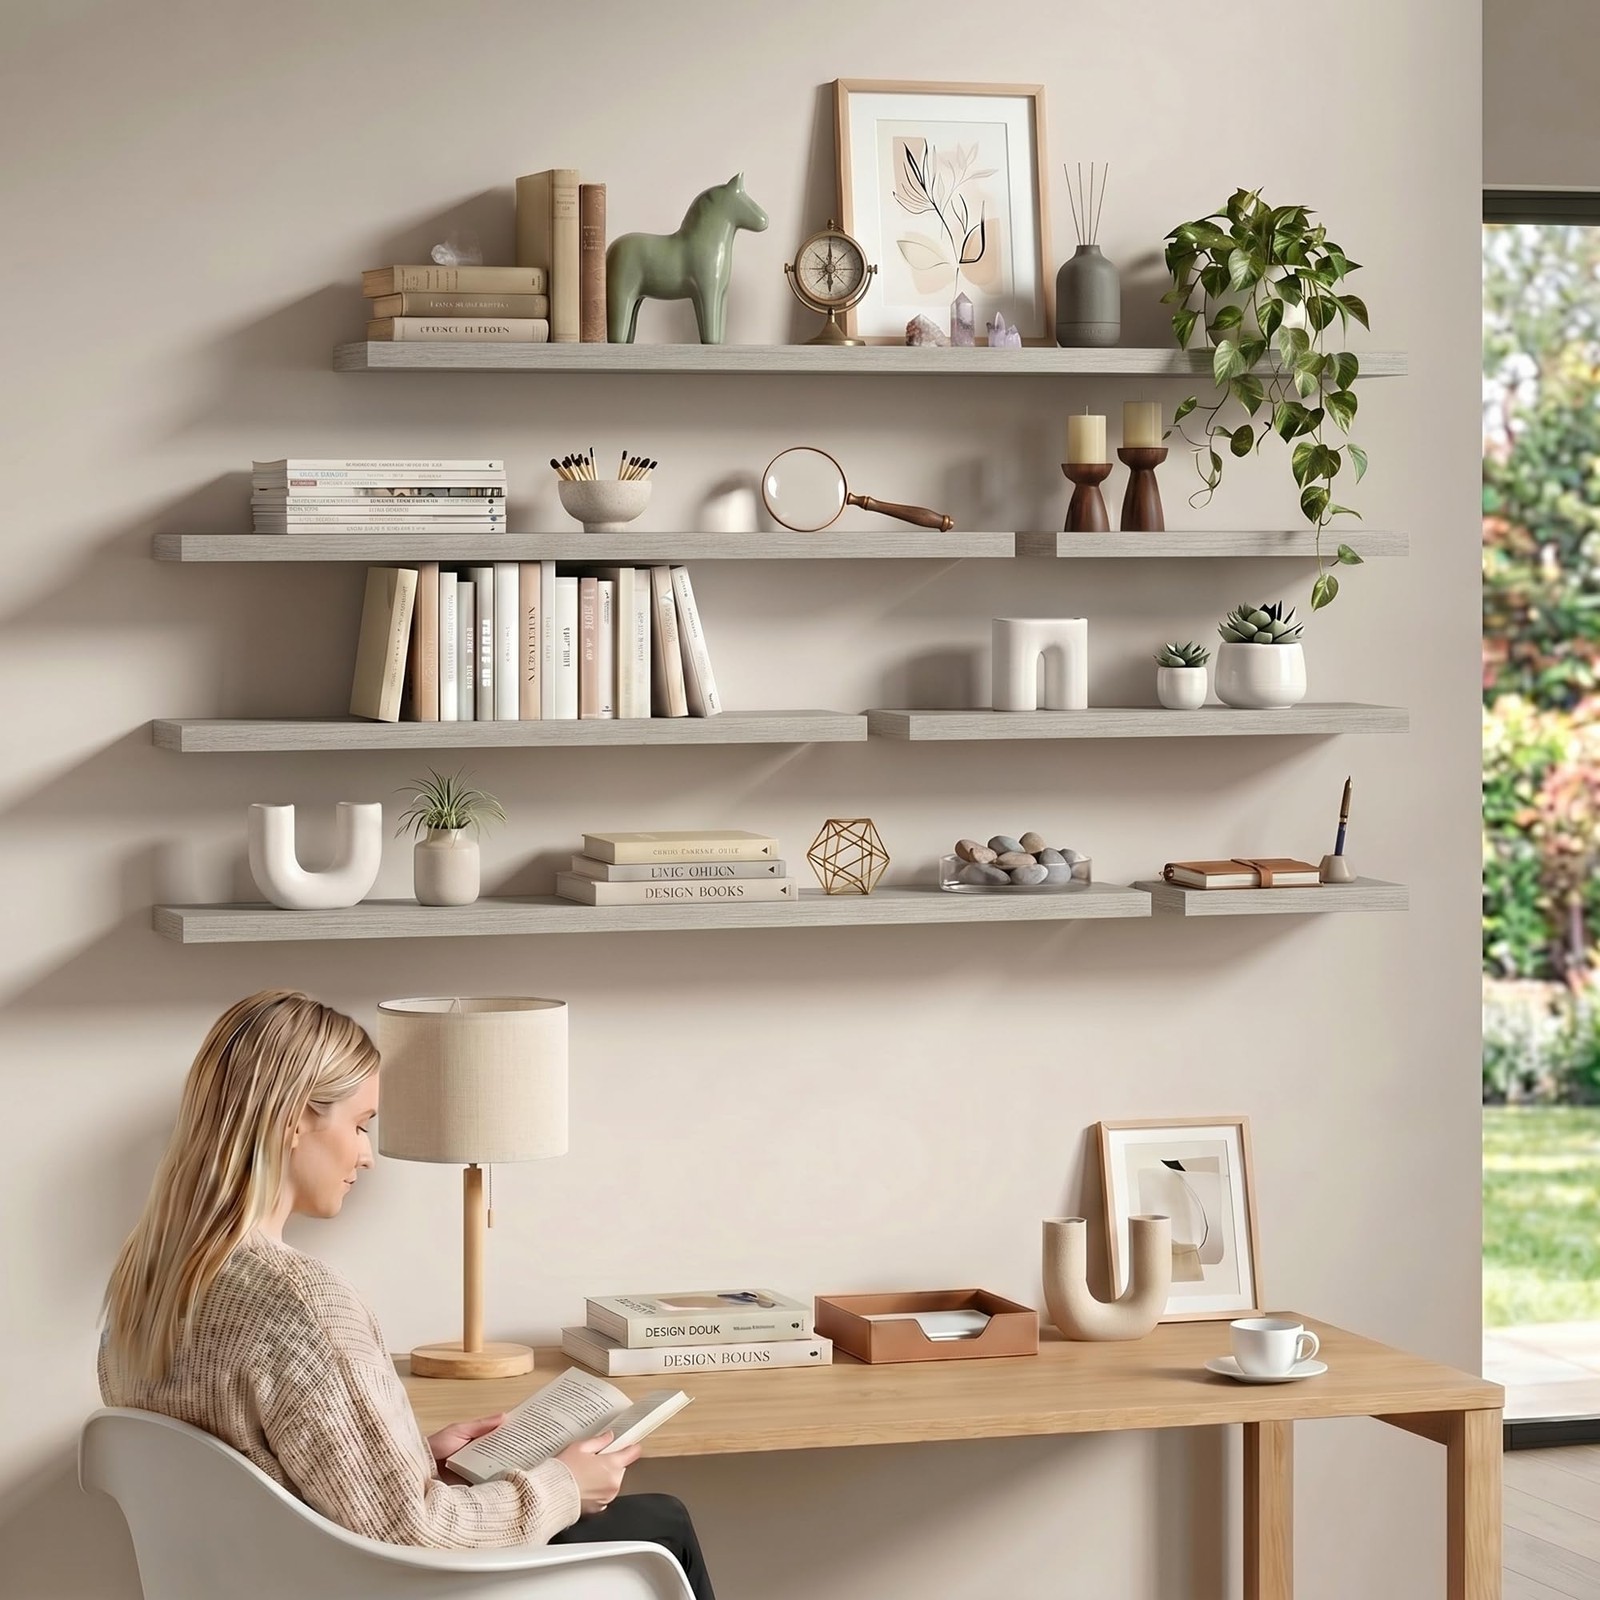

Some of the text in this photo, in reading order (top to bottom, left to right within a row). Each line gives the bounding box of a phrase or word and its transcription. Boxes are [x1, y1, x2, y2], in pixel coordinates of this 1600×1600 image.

[645, 885, 744, 898] DESIGN BOOKS
[645, 1326, 686, 1337] DESIGN
[689, 1324, 720, 1335] DOUK
[721, 1350, 770, 1363] BOUNS
